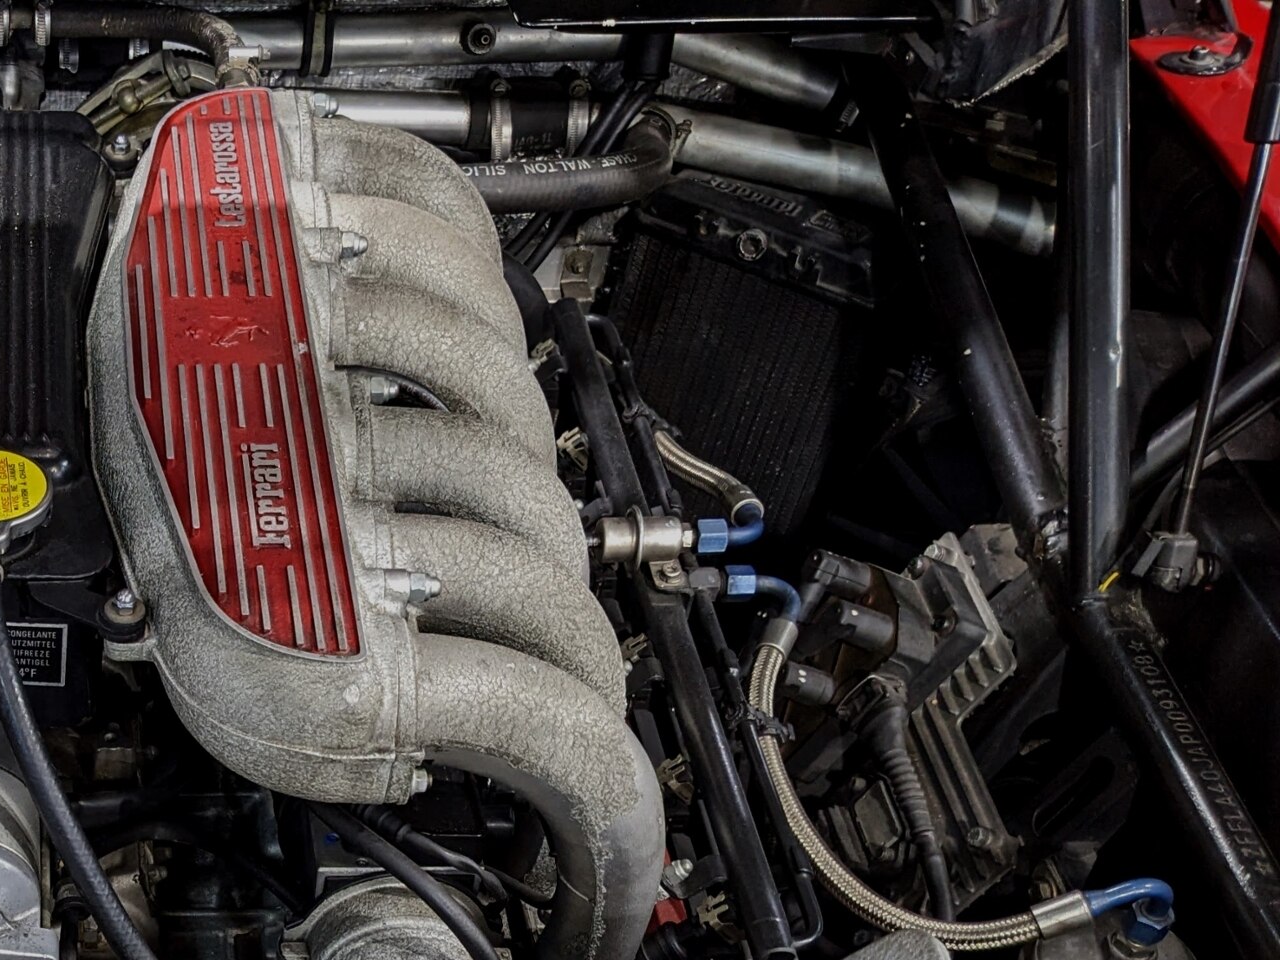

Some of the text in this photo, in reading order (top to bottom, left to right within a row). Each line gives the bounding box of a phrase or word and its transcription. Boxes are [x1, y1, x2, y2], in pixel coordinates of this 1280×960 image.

[0, 484, 8, 493] EN
[240, 442, 292, 550] Ferrari
[8, 629, 57, 639] ONGELANTE
[11, 638, 57, 648] UTZMITTEL
[13, 650, 51, 658] TIFREEZE
